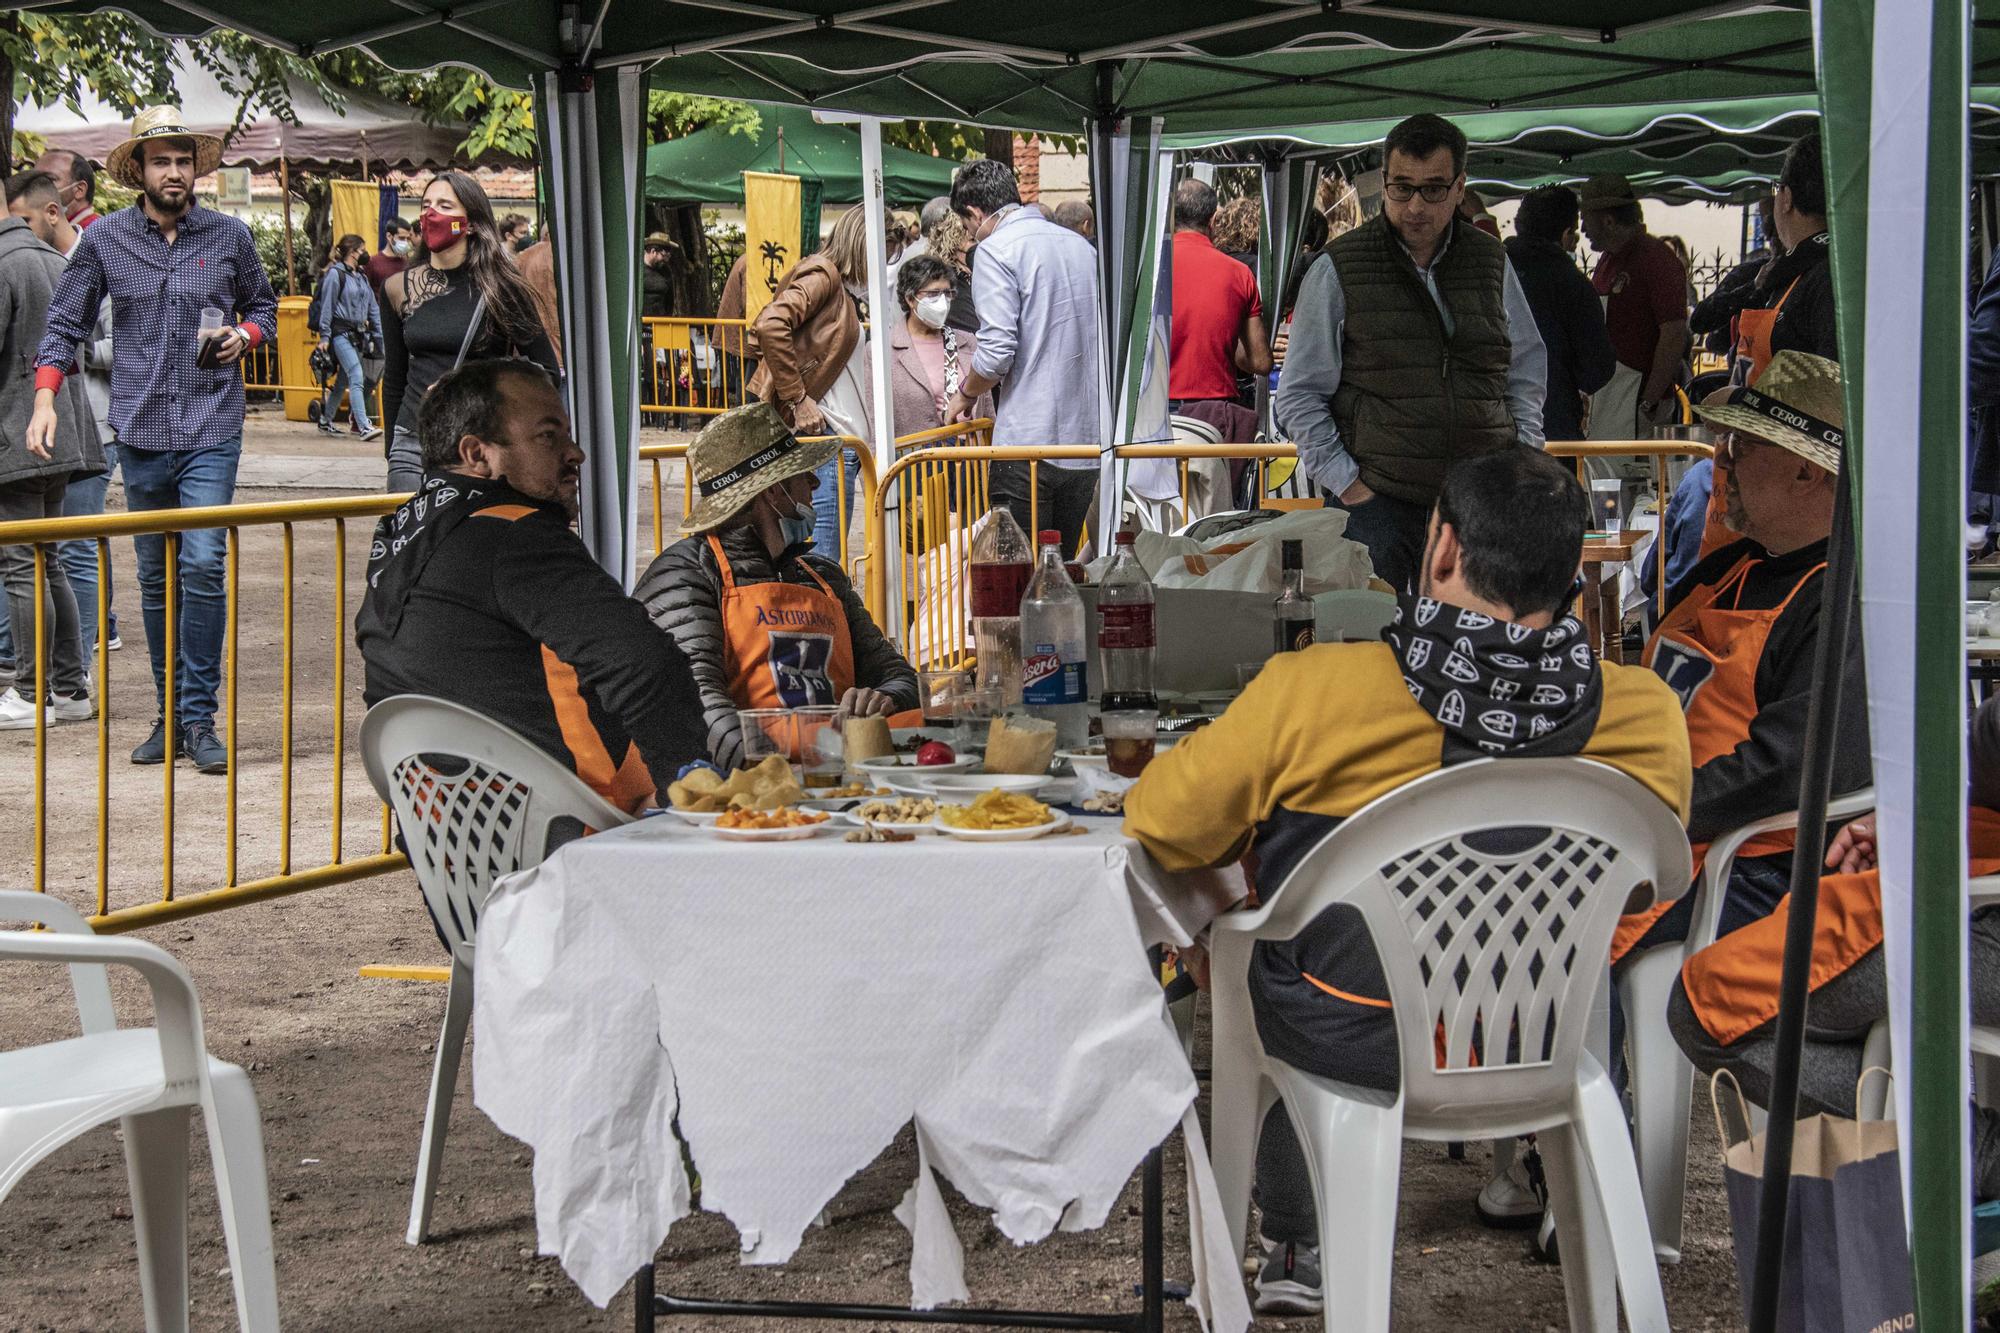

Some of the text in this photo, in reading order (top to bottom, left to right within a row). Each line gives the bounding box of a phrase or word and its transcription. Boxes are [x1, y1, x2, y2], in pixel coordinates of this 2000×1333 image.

[148, 126, 172, 138] CEROL
[1769, 405, 1810, 432] CEROL
[711, 469, 743, 491] CEROL
[749, 447, 782, 470] CEROL
